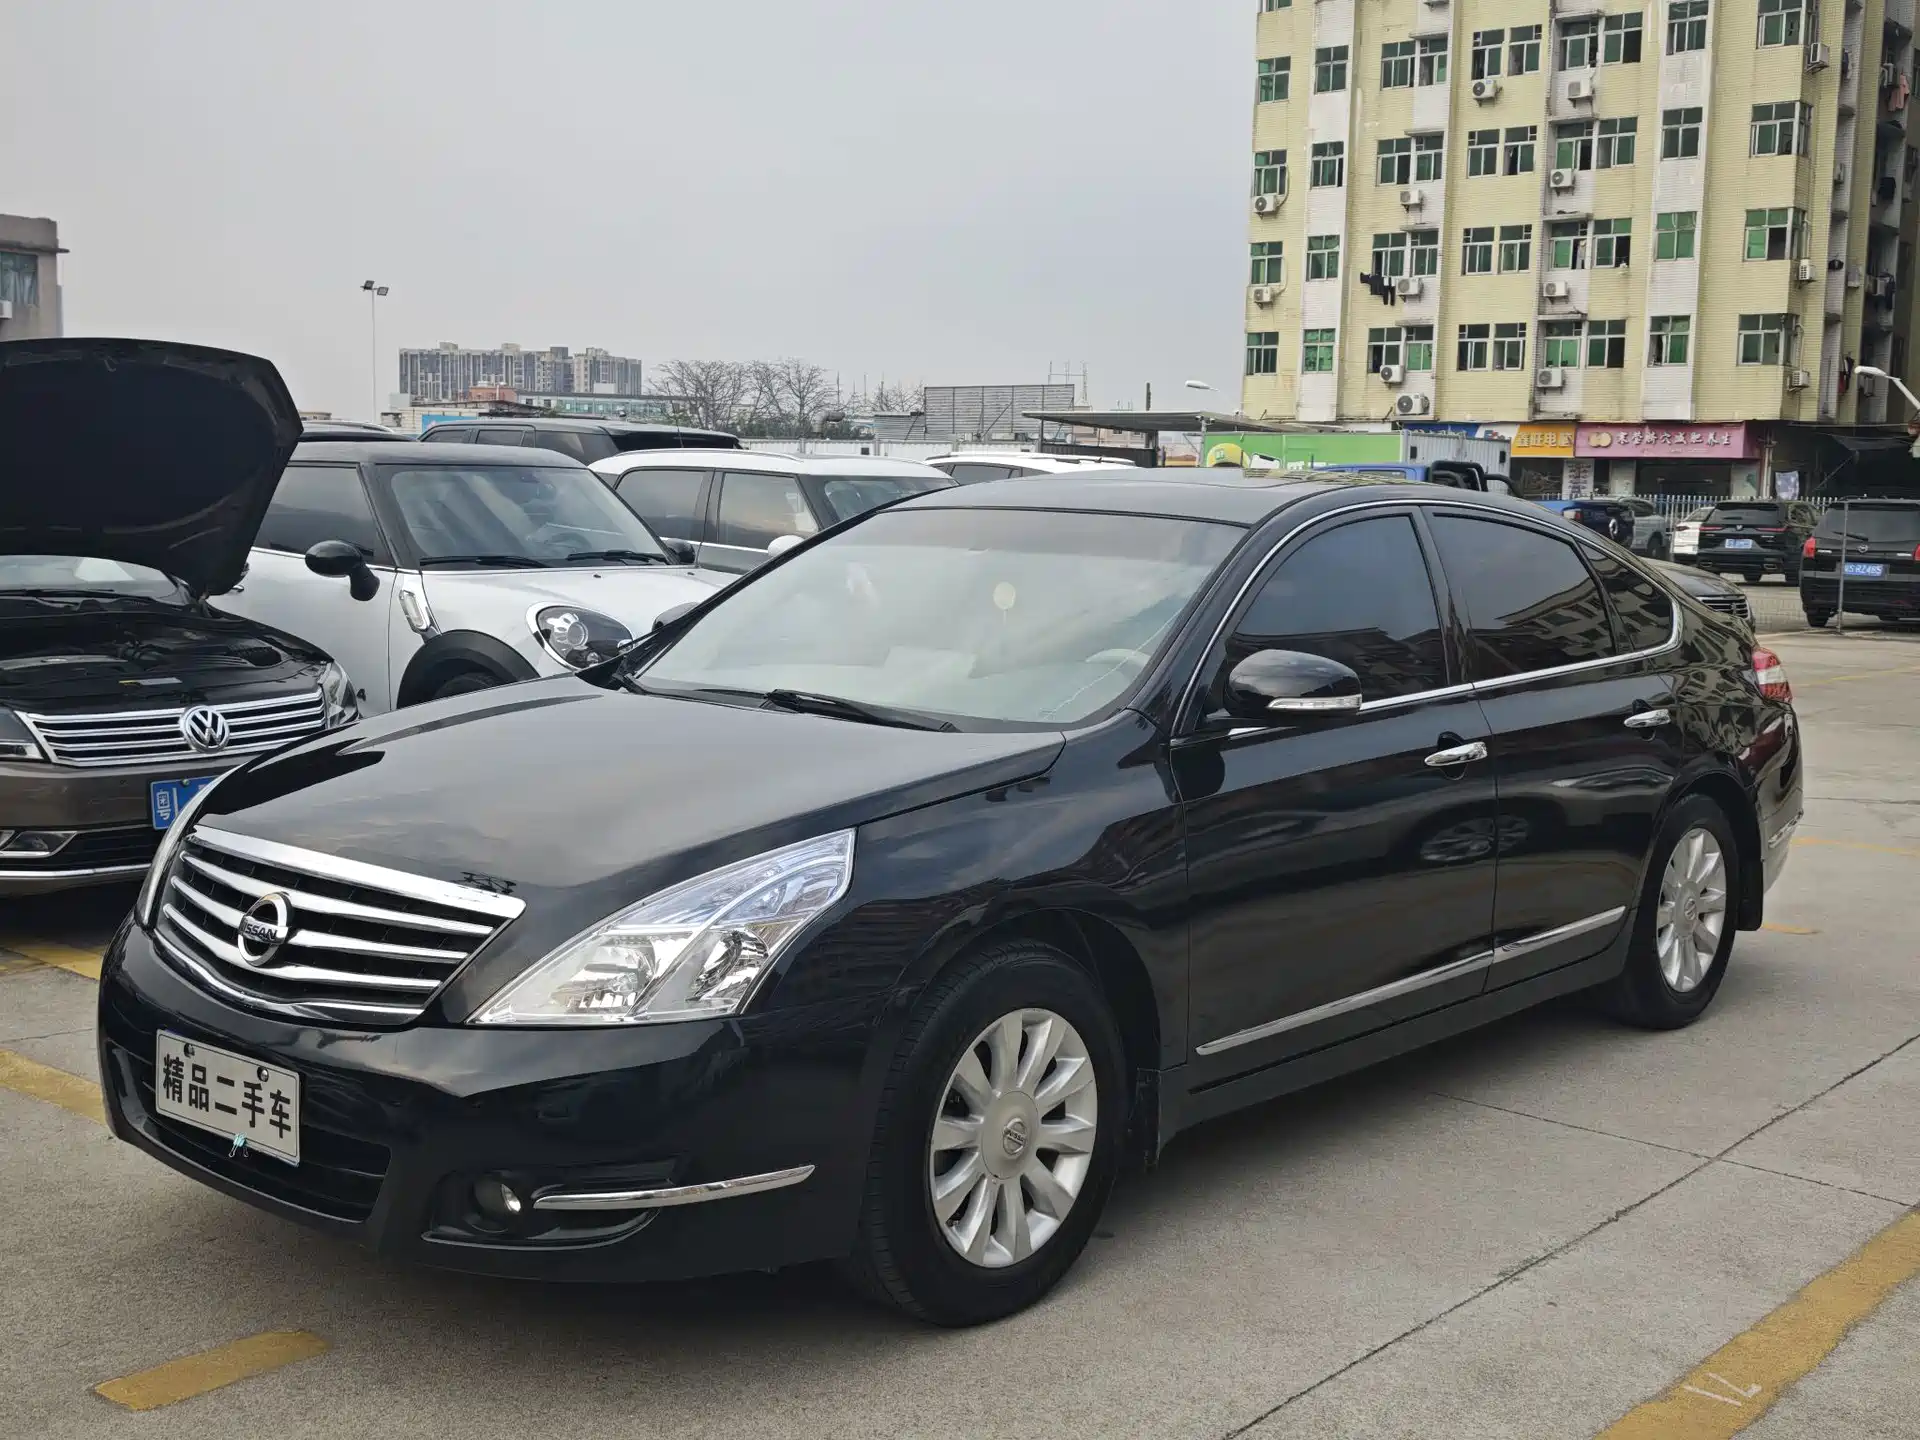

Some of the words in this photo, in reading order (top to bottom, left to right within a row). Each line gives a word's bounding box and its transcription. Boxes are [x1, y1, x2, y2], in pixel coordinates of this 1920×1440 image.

[162, 1053, 292, 1139] 精品二手车
